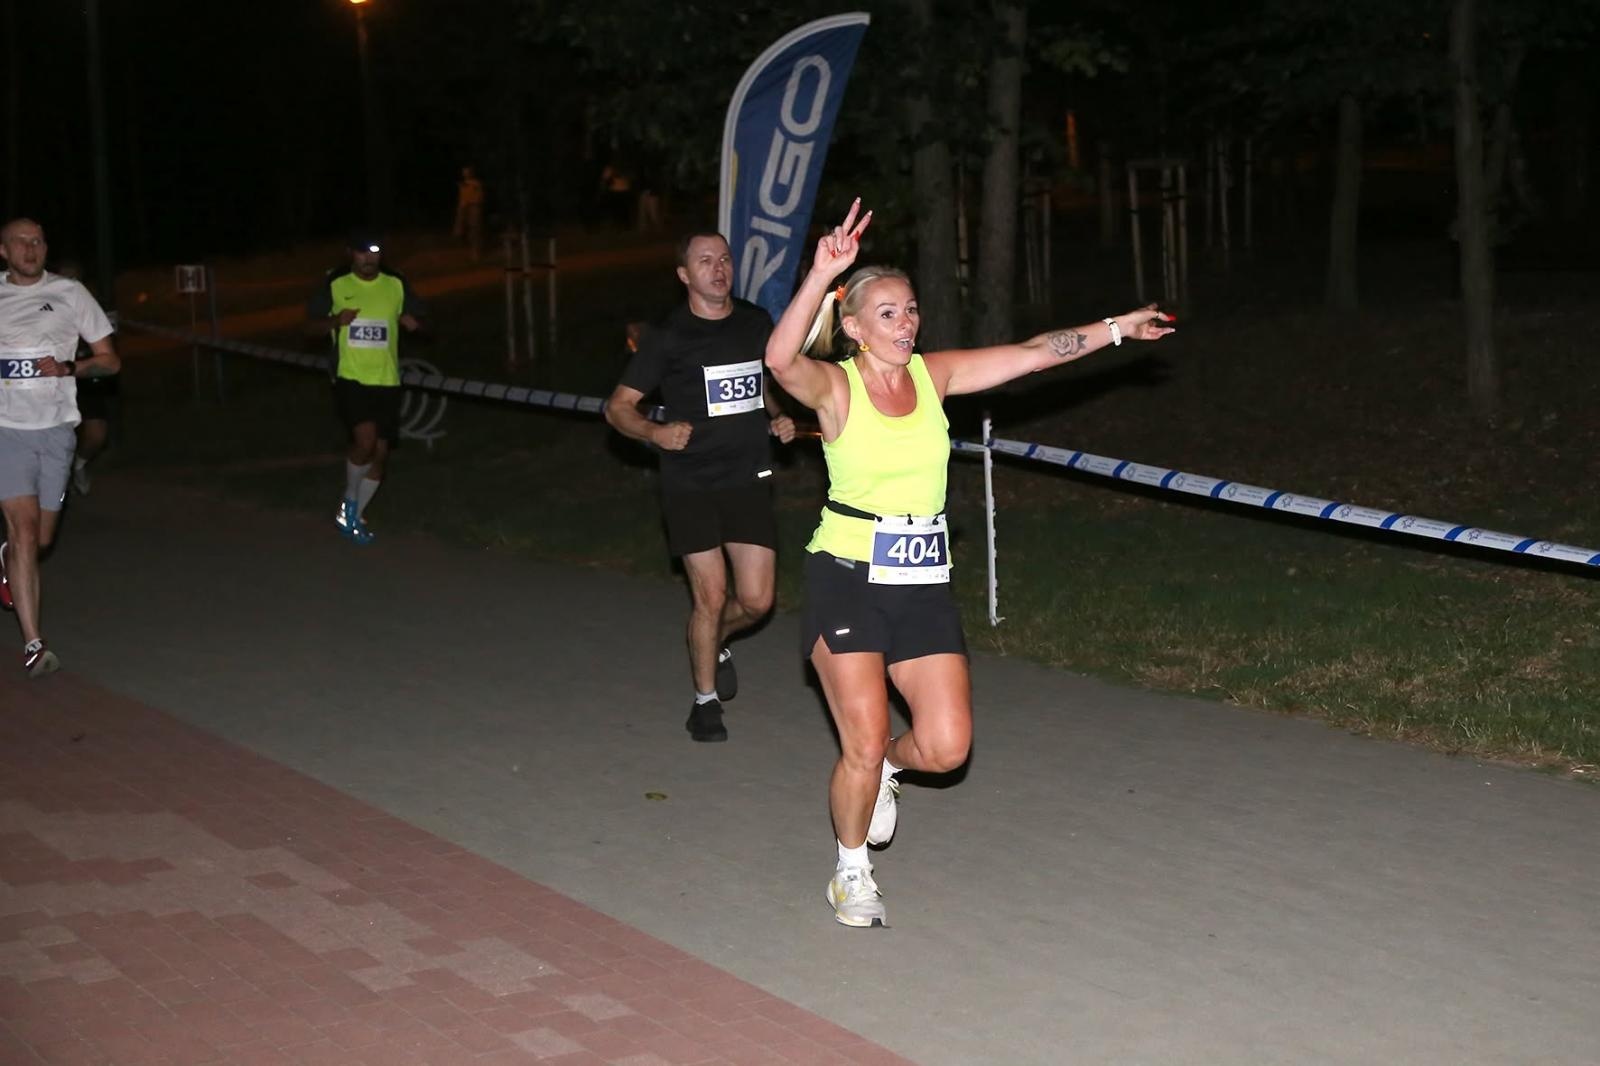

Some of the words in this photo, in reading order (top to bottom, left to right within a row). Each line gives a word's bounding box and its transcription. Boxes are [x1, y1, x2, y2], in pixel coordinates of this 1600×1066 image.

[355, 327, 382, 340] 433
[719, 376, 757, 400] 353
[887, 535, 940, 564] 404
